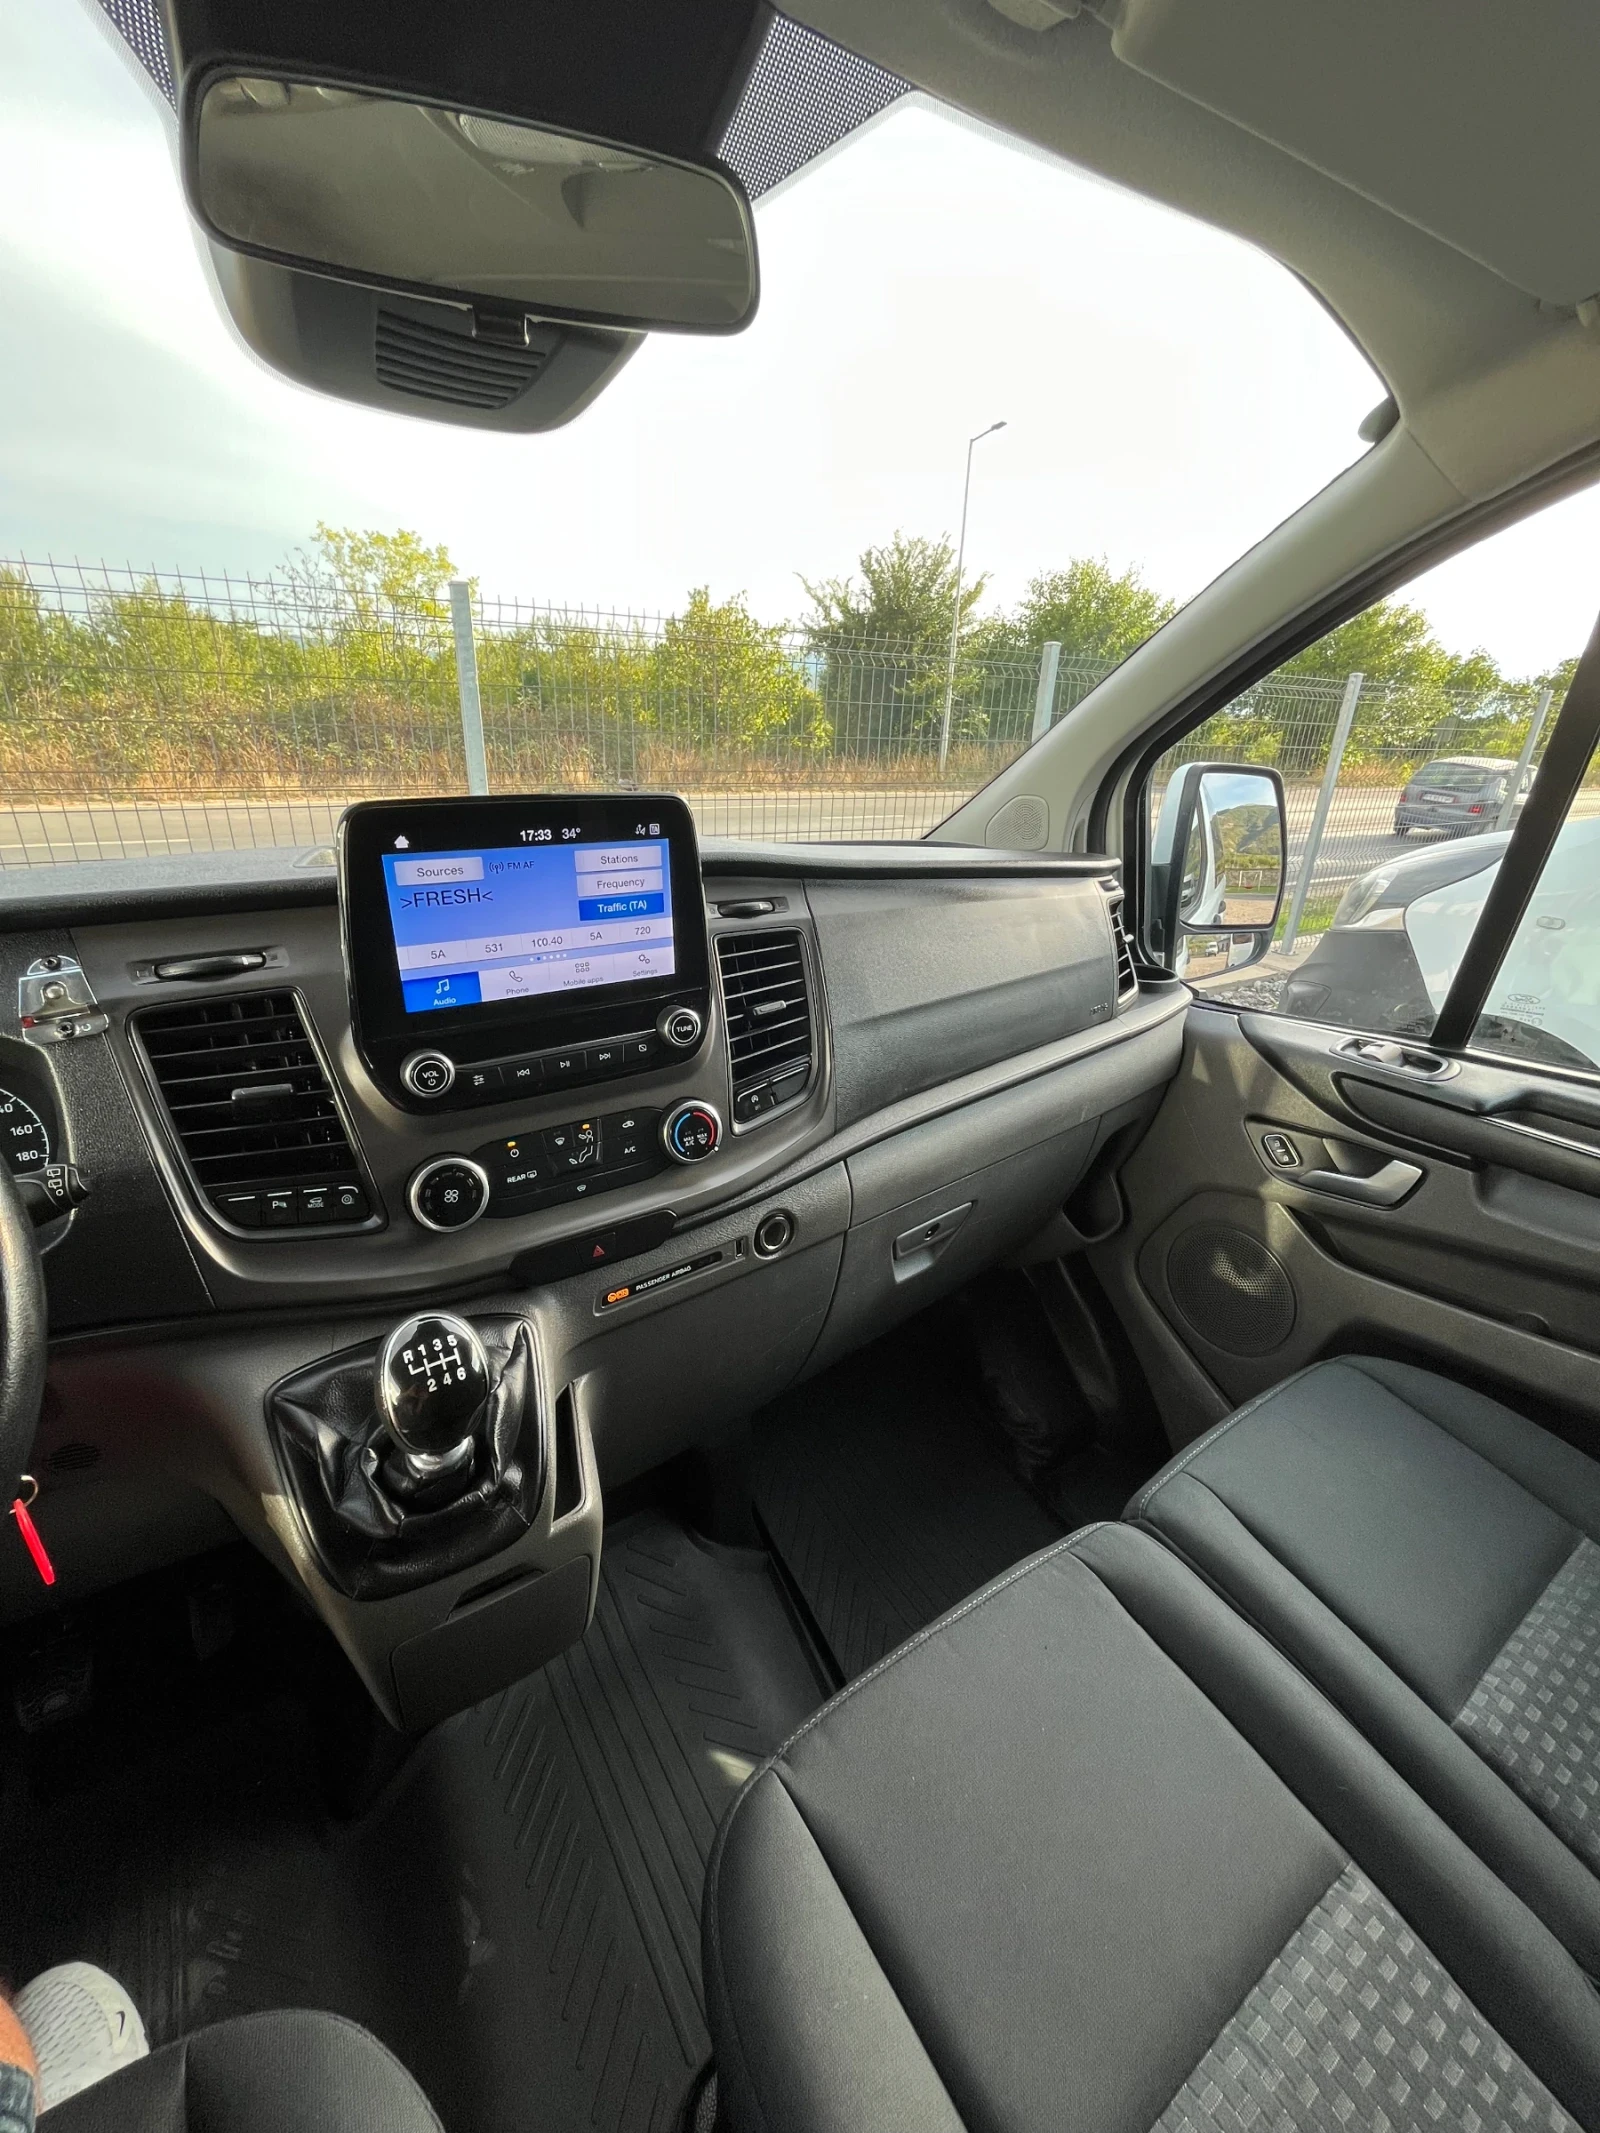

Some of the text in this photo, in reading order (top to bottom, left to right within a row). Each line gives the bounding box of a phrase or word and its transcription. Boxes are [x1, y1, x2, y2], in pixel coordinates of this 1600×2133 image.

[520, 828, 581, 841] 17:33 34°
[507, 860, 535, 870] FM AF
[600, 855, 639, 865] Stations
[416, 866, 464, 878] Sources
[596, 878, 645, 889] Frequency
[400, 887, 494, 909] >FRESH<
[597, 900, 647, 913] Traffic (TA)
[634, 926, 651, 935] 720
[589, 931, 603, 941] 5A
[485, 943, 504, 953] 531
[431, 949, 446, 959] 5A
[632, 968, 658, 977] Settings
[563, 976, 604, 987] Mobile apps
[505, 987, 530, 995] Phone
[433, 997, 457, 1006] Audio
[676, 1024, 693, 1032] TUNE
[422, 1070, 440, 1079] VOL
[9, 1124, 33, 1136] 160
[624, 1146, 636, 1154] A/C
[15, 1150, 38, 1161] 180
[507, 1174, 526, 1183] REAR
[403, 1335, 457, 1363] R 1 3 5
[426, 1367, 466, 1393] 2 4 6
